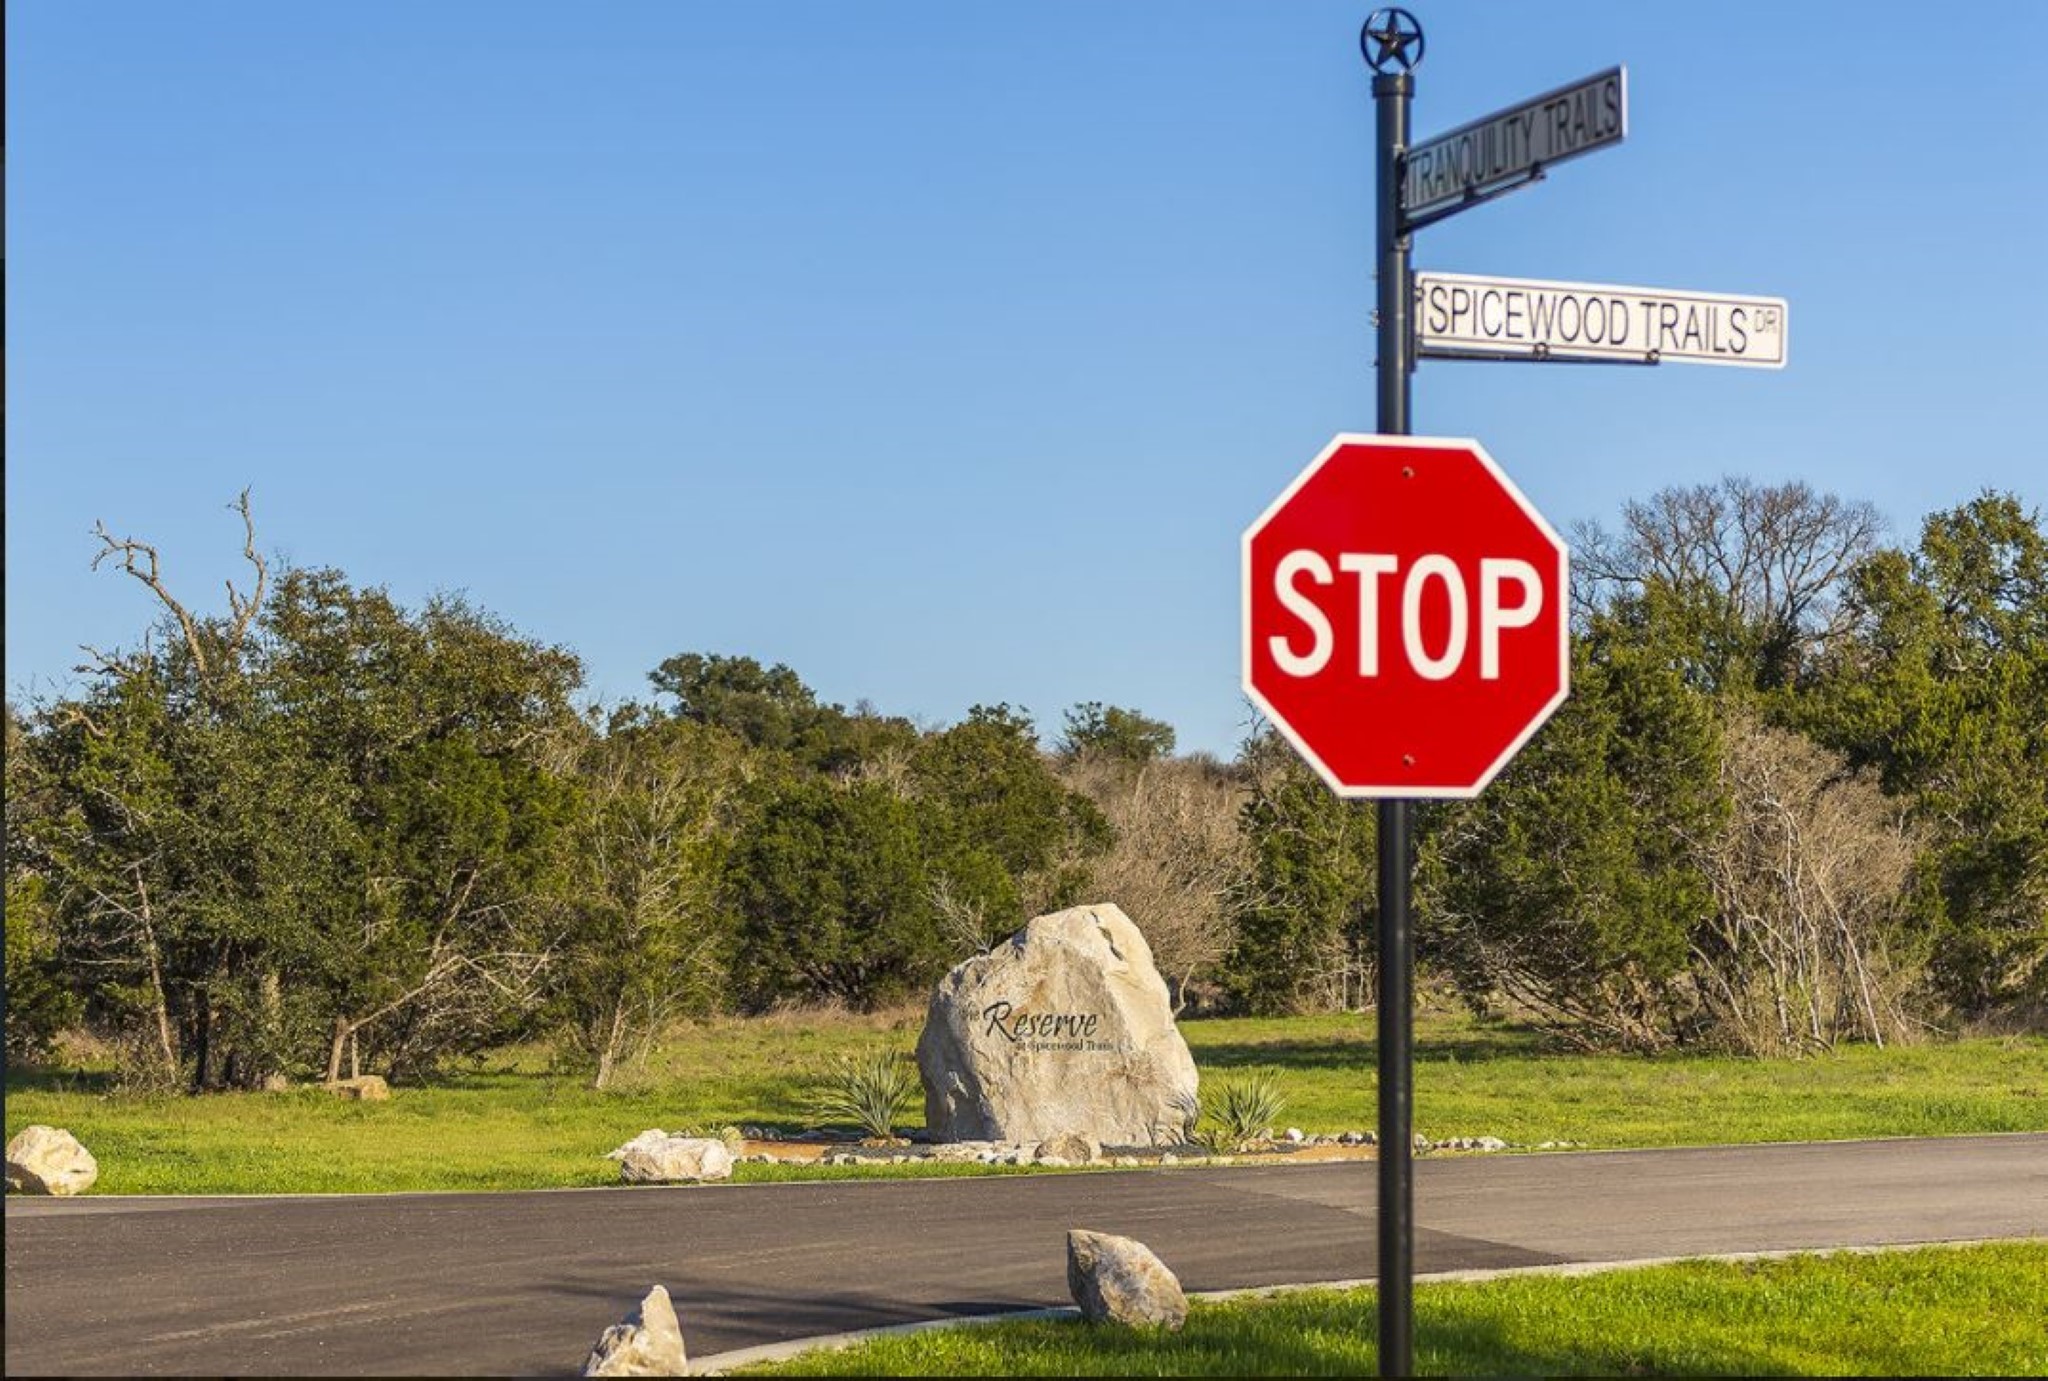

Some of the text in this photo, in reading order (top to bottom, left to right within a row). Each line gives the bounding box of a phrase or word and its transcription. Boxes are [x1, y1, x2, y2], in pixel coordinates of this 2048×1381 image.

[1409, 79, 1619, 206] TRANQUILITY TRAILS
[1429, 285, 1630, 347] SPICEWOOD
[1640, 301, 1748, 355] TRAILS
[1268, 549, 1544, 681] STOP
[983, 1001, 1097, 1042] Reserve
